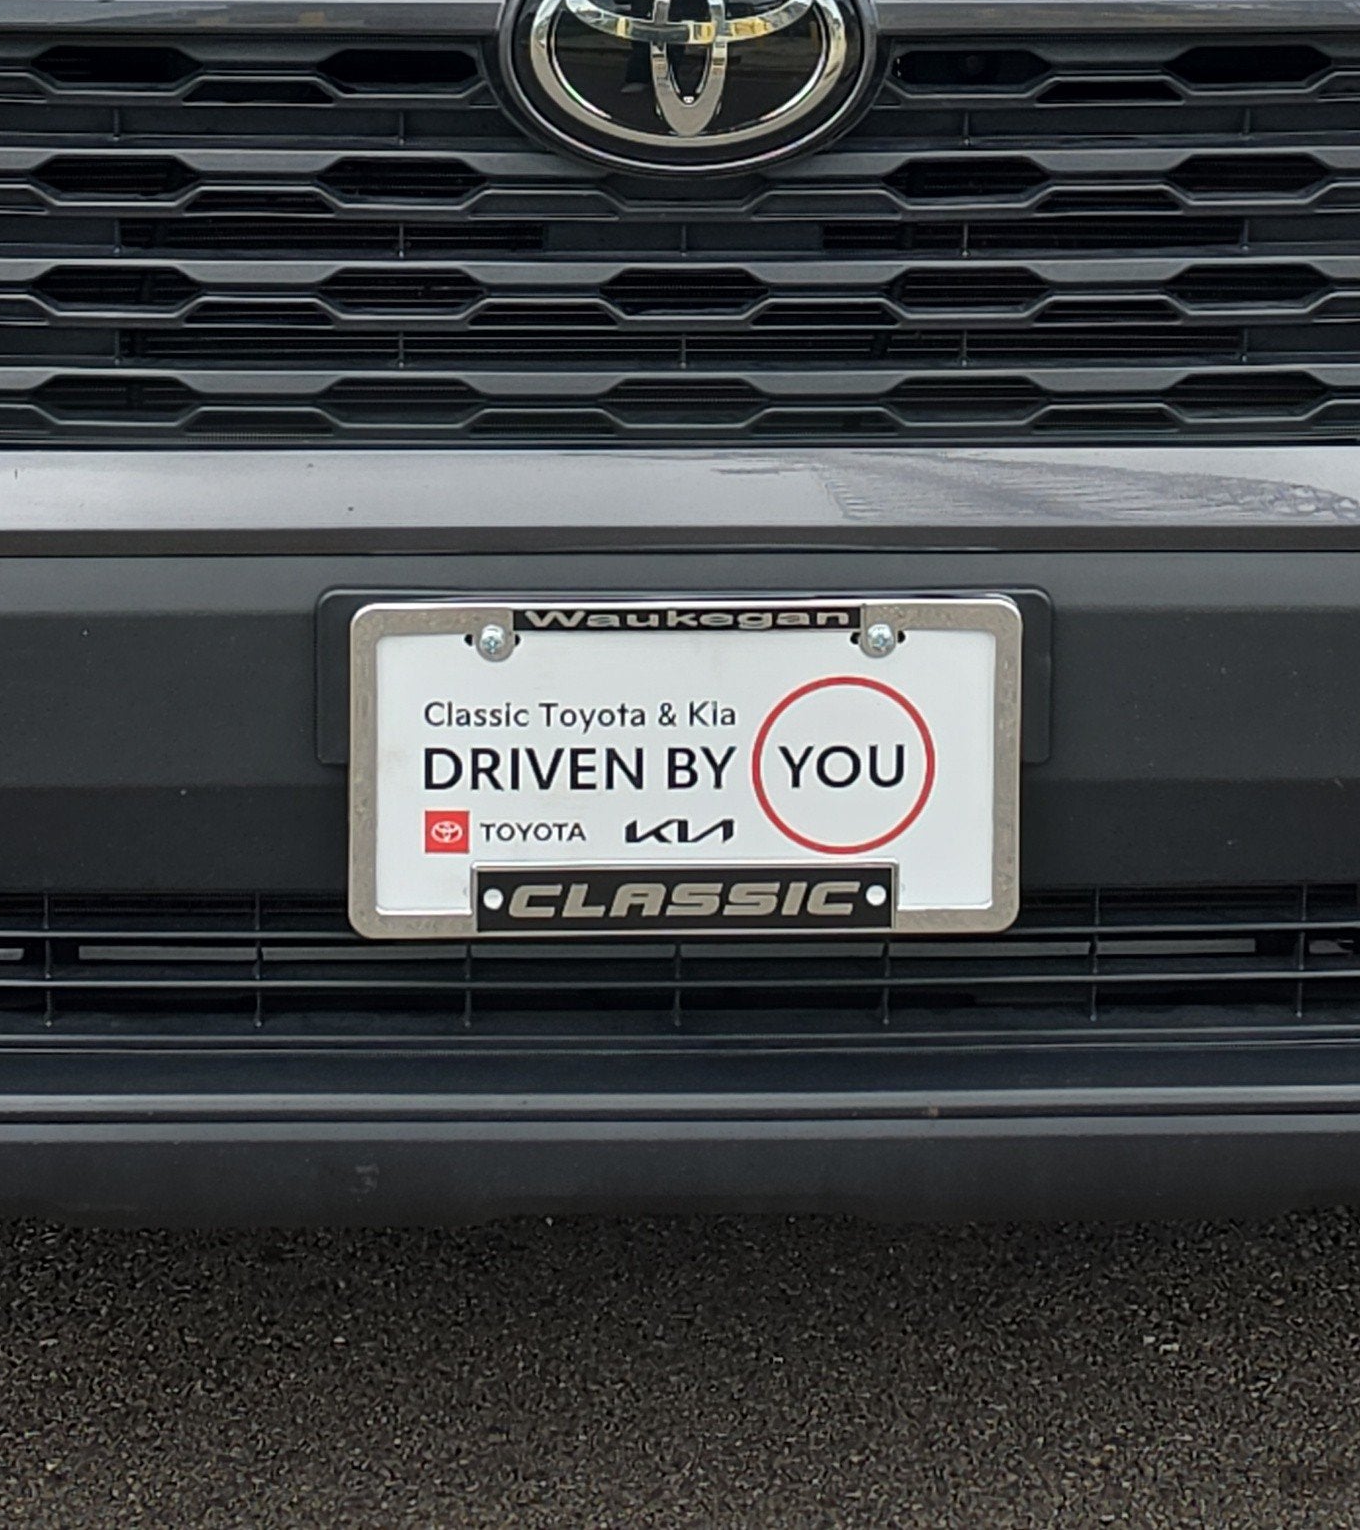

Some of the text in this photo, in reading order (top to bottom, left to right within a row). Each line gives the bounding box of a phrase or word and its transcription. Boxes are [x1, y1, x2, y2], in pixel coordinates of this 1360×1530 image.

[524, 610, 849, 629] Waukegan
[424, 701, 736, 733] Classic Toyota & Kia
[424, 744, 906, 791] DRIVEN BY YOU
[480, 823, 587, 842] TOYOTA
[508, 881, 861, 918] CLASSIC
